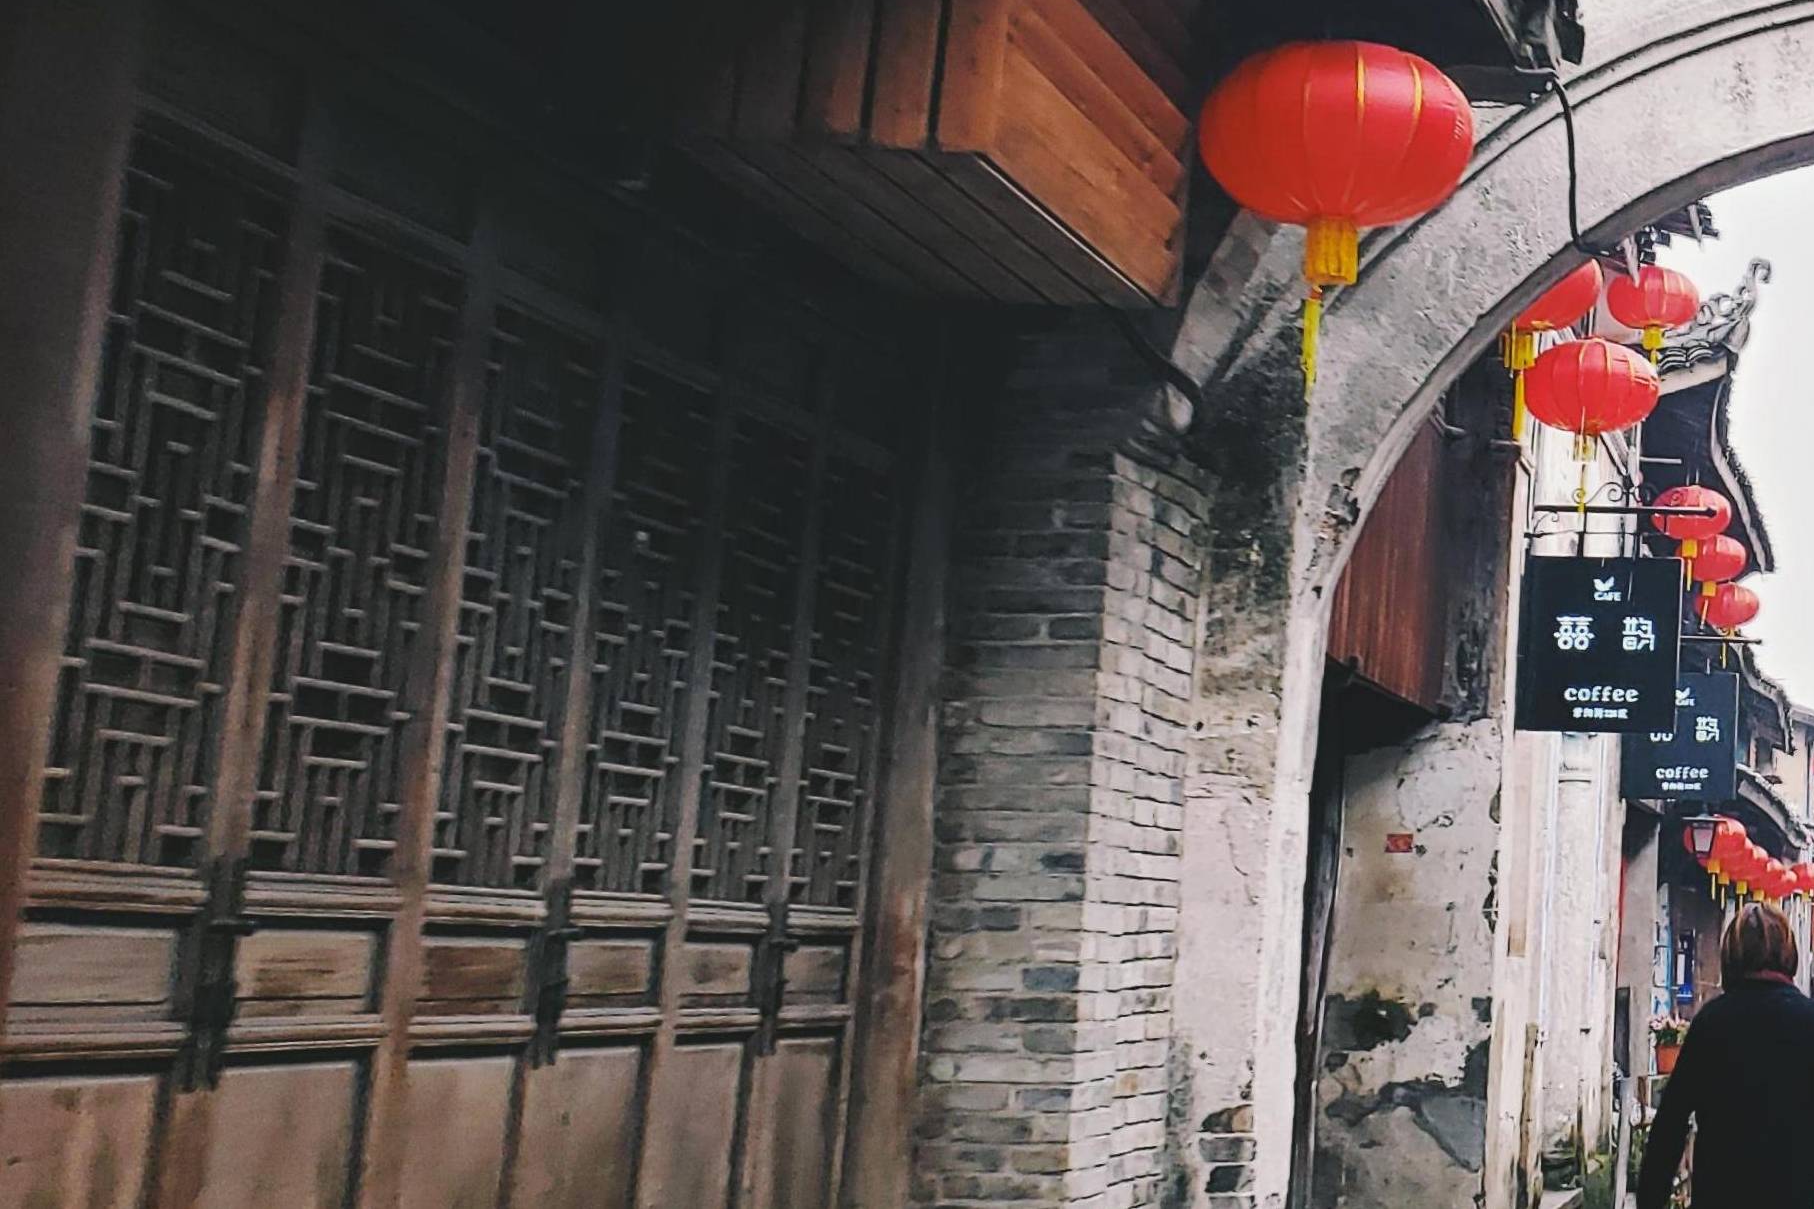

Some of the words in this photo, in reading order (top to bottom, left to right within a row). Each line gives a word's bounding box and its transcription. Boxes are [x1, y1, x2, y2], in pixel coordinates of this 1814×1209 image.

[1594, 591, 1621, 601] CAFE
[1564, 685, 1640, 702] coffee
[1655, 765, 1710, 780] coffee
